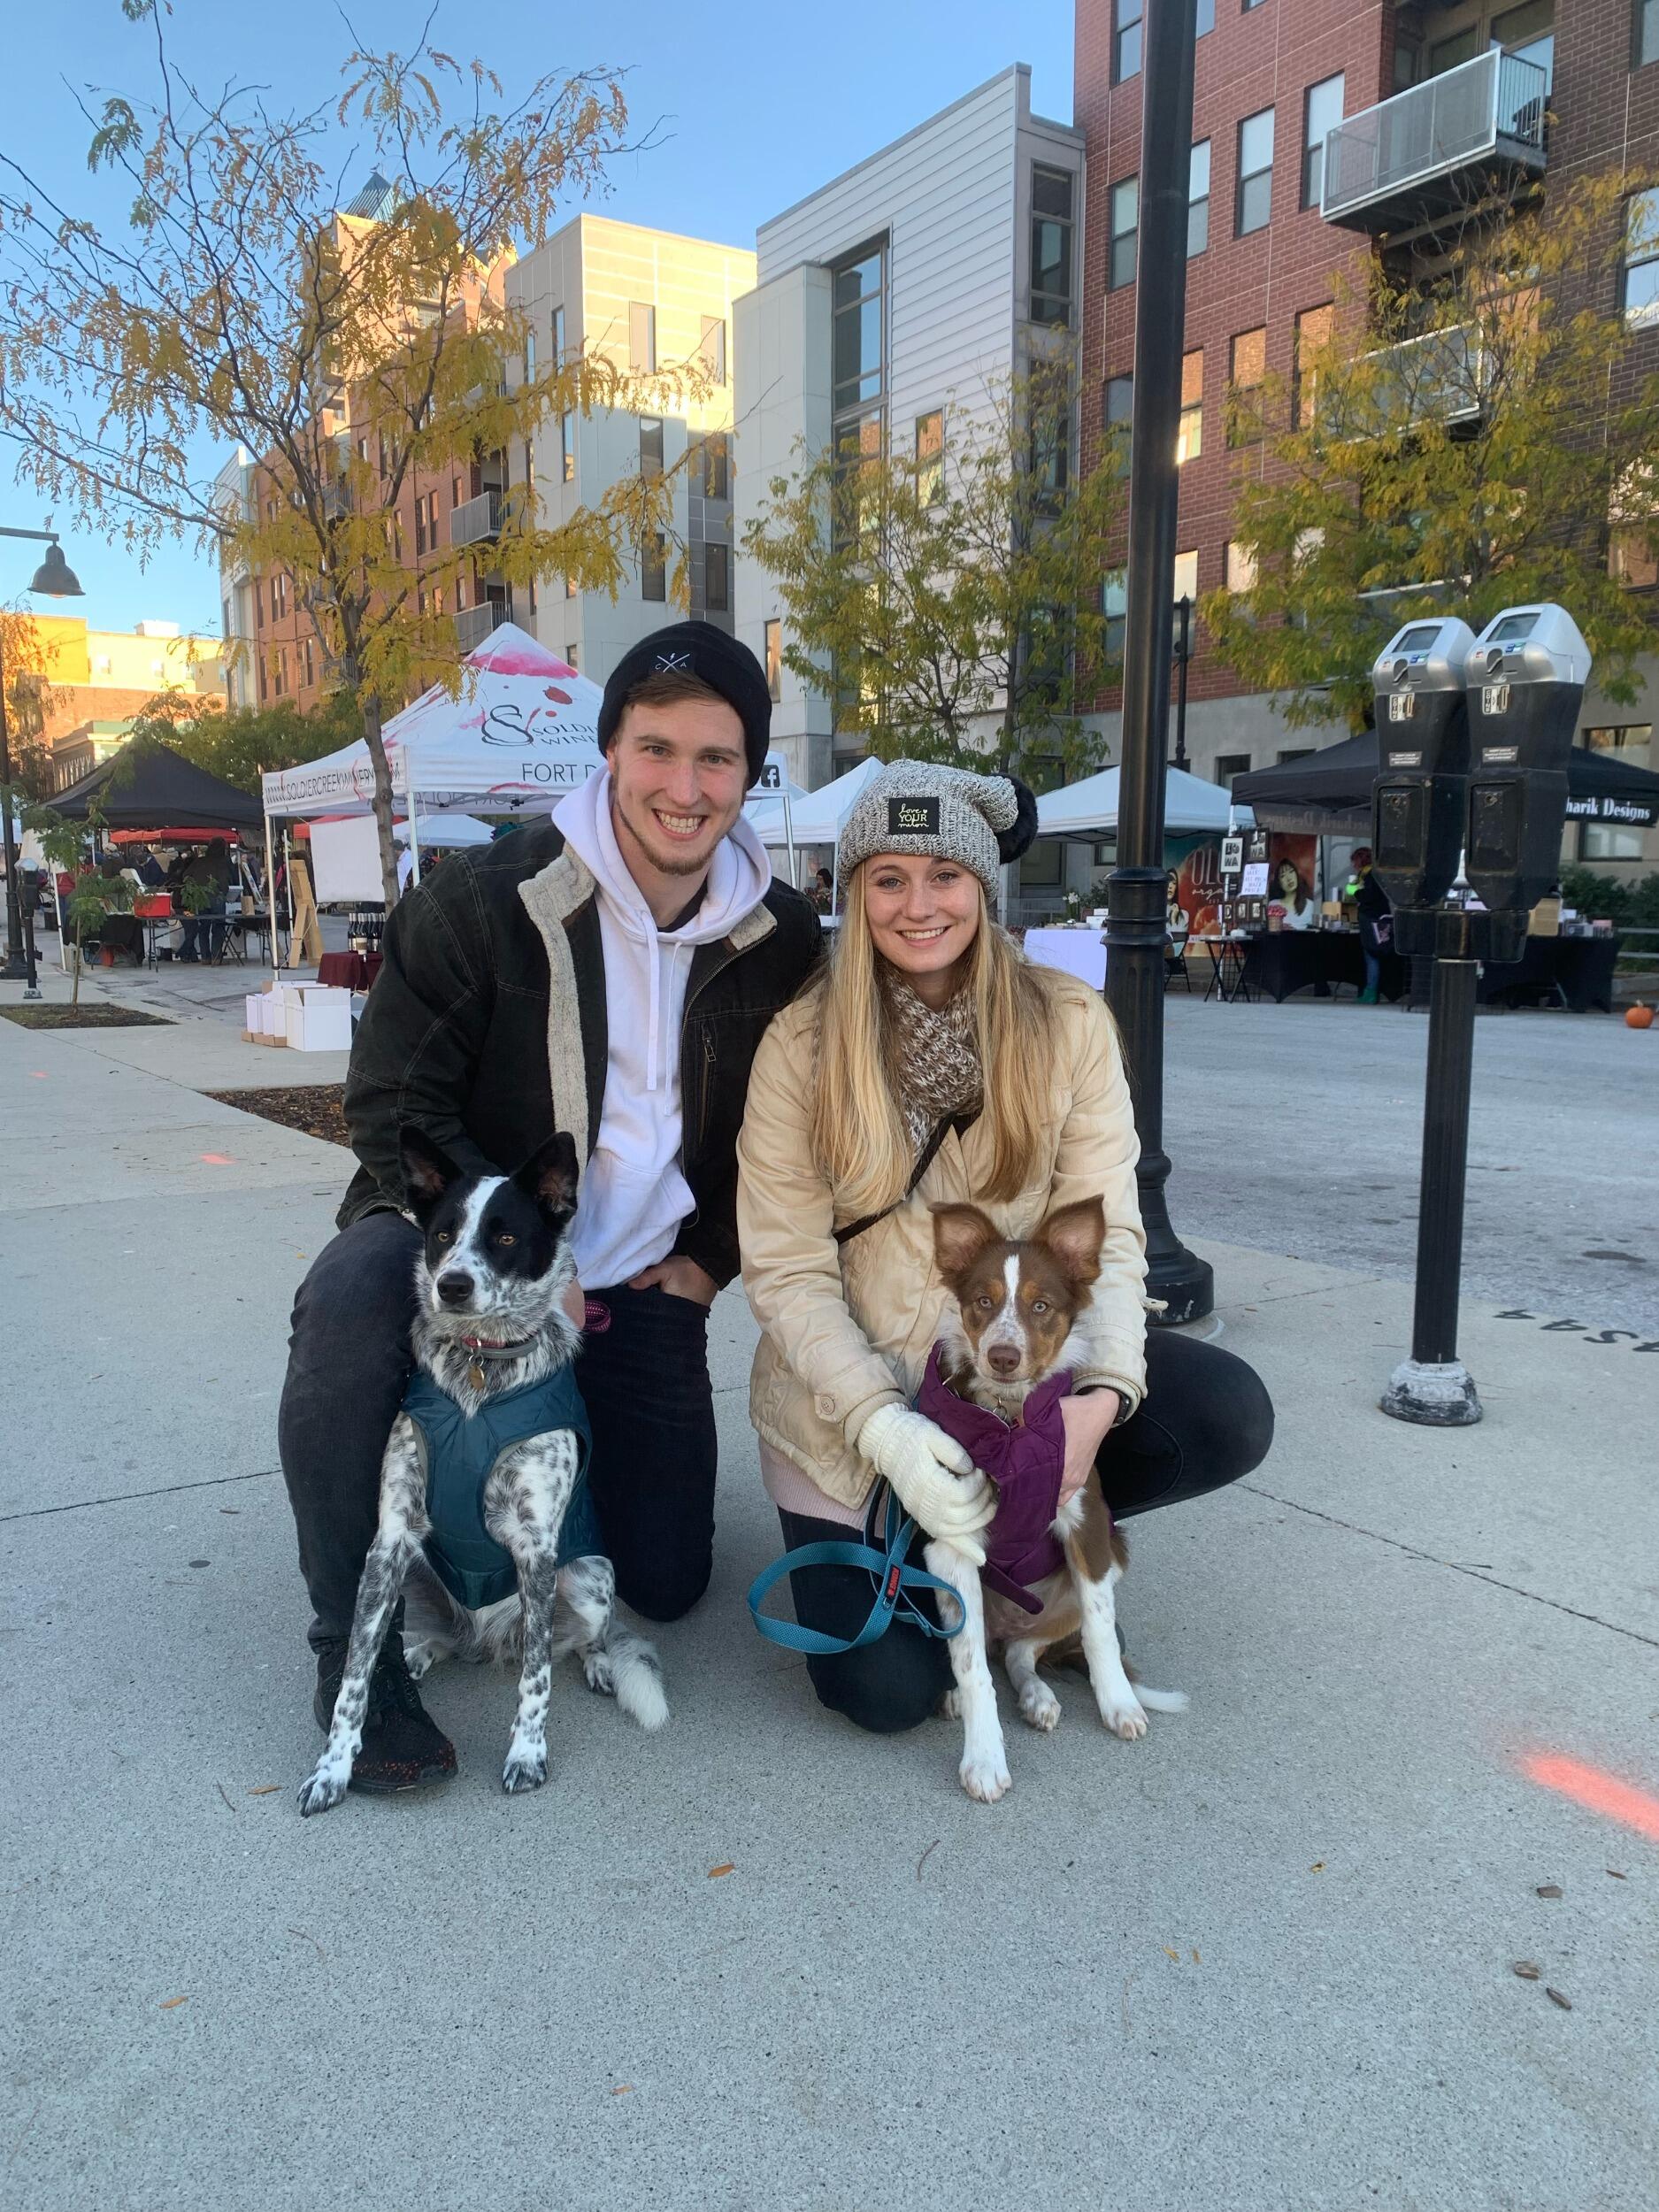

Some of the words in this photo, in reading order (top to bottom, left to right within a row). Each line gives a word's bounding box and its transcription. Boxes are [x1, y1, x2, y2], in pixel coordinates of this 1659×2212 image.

[532, 723, 598, 736] SOLDI
[522, 763, 577, 782] FORT
[898, 803, 922, 814] love
[1565, 795, 1599, 815] harik
[1602, 798, 1651, 822] Designs
[899, 813, 927, 823] YOUR
